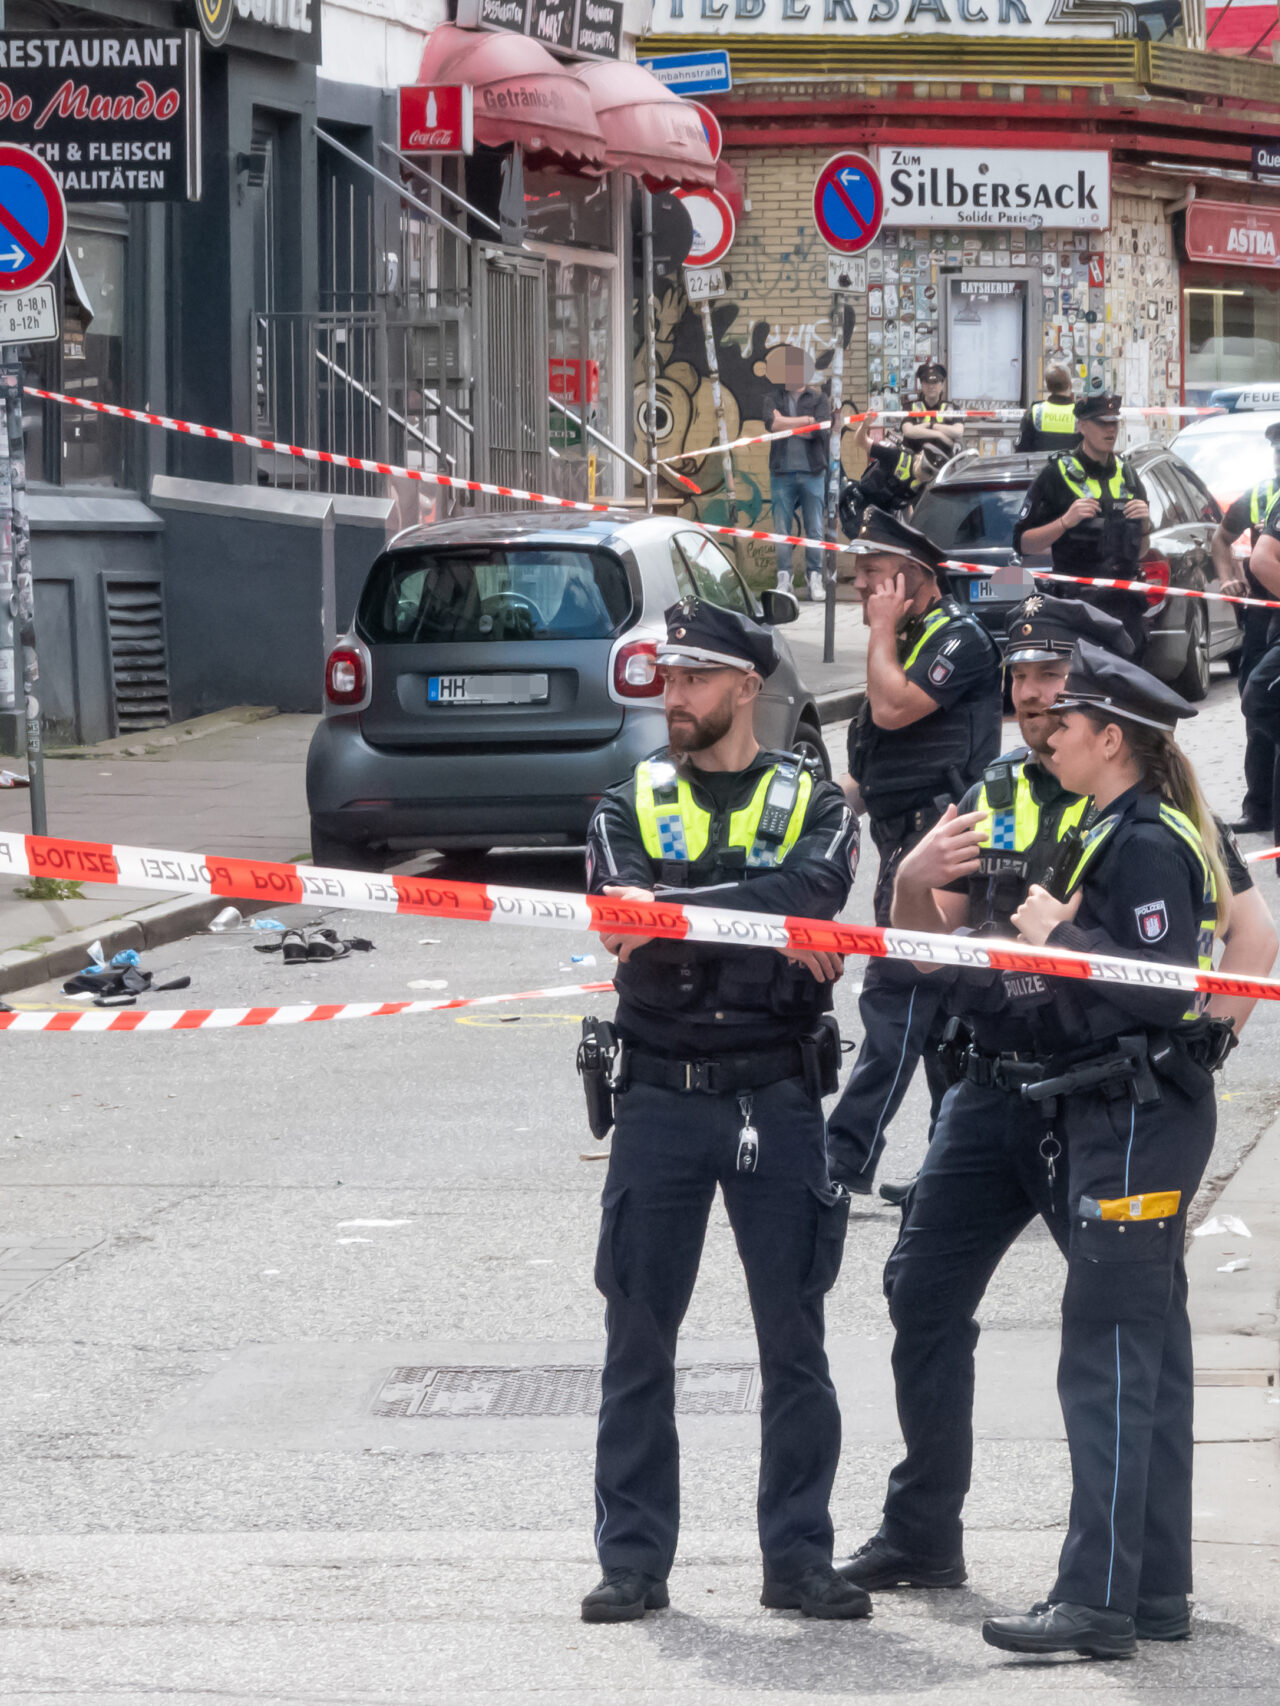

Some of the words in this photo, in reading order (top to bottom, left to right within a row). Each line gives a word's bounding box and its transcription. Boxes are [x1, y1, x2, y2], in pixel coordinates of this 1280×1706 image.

[34, 79, 181, 130] Mundo
[67, 142, 82, 161] &
[89, 142, 171, 161] FLEISCH
[1227, 228, 1276, 256] ASTRA
[1137, 903, 1164, 915] POLIZEI
